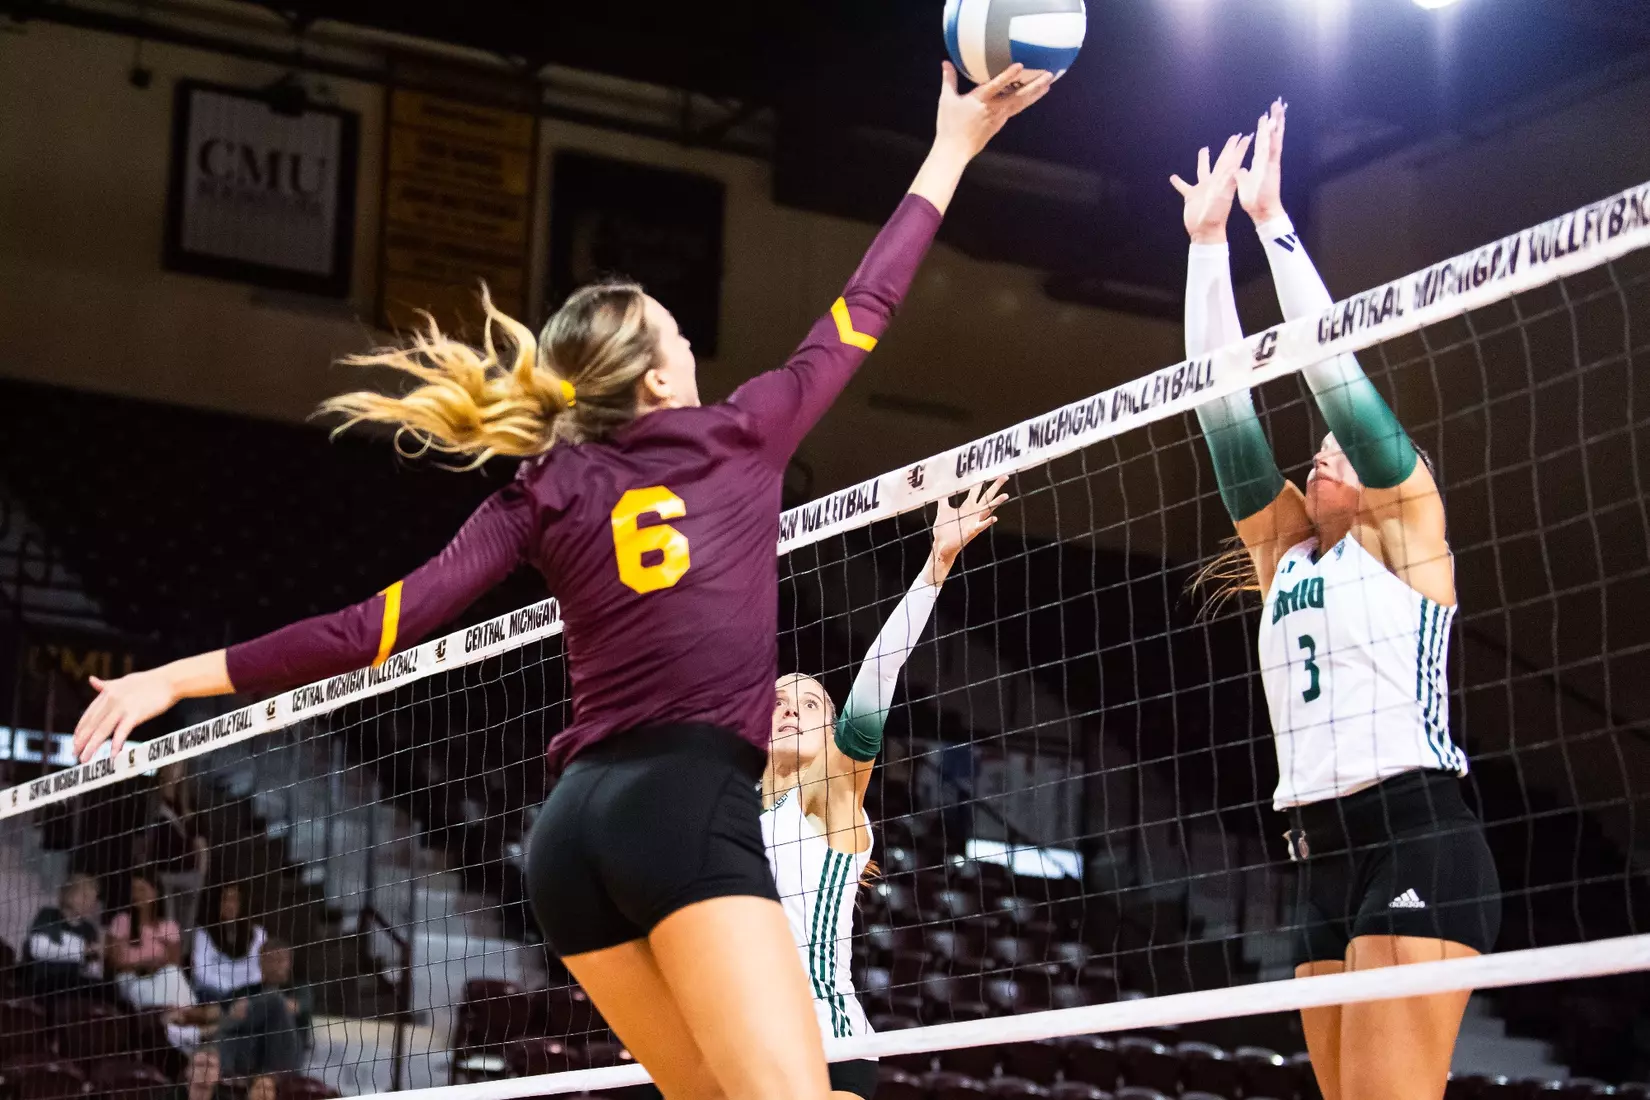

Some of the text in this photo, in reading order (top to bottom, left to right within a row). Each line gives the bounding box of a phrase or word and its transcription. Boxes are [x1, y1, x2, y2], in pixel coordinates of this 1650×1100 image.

[199, 138, 326, 195] CMU
[801, 479, 880, 532] VOLLEYBALL
[955, 430, 1022, 479] CENTRAL
[1028, 399, 1106, 453] MICHIGAN
[1111, 358, 1216, 423] VOLLEYBALL
[1316, 290, 1405, 345] CENTRAL
[1412, 236, 1520, 310] MICHIGAN
[611, 485, 691, 594] 6
[148, 739, 175, 762] CENTRAL
[178, 725, 210, 752] MICHIGAN
[212, 708, 253, 738] VOLLEYBALL
[292, 688, 325, 713] CENTRAL
[326, 671, 365, 701] MICHIGAN
[465, 617, 506, 654] CENTRAL
[509, 599, 558, 639] MICHIGAN
[1298, 634, 1321, 703] 3
